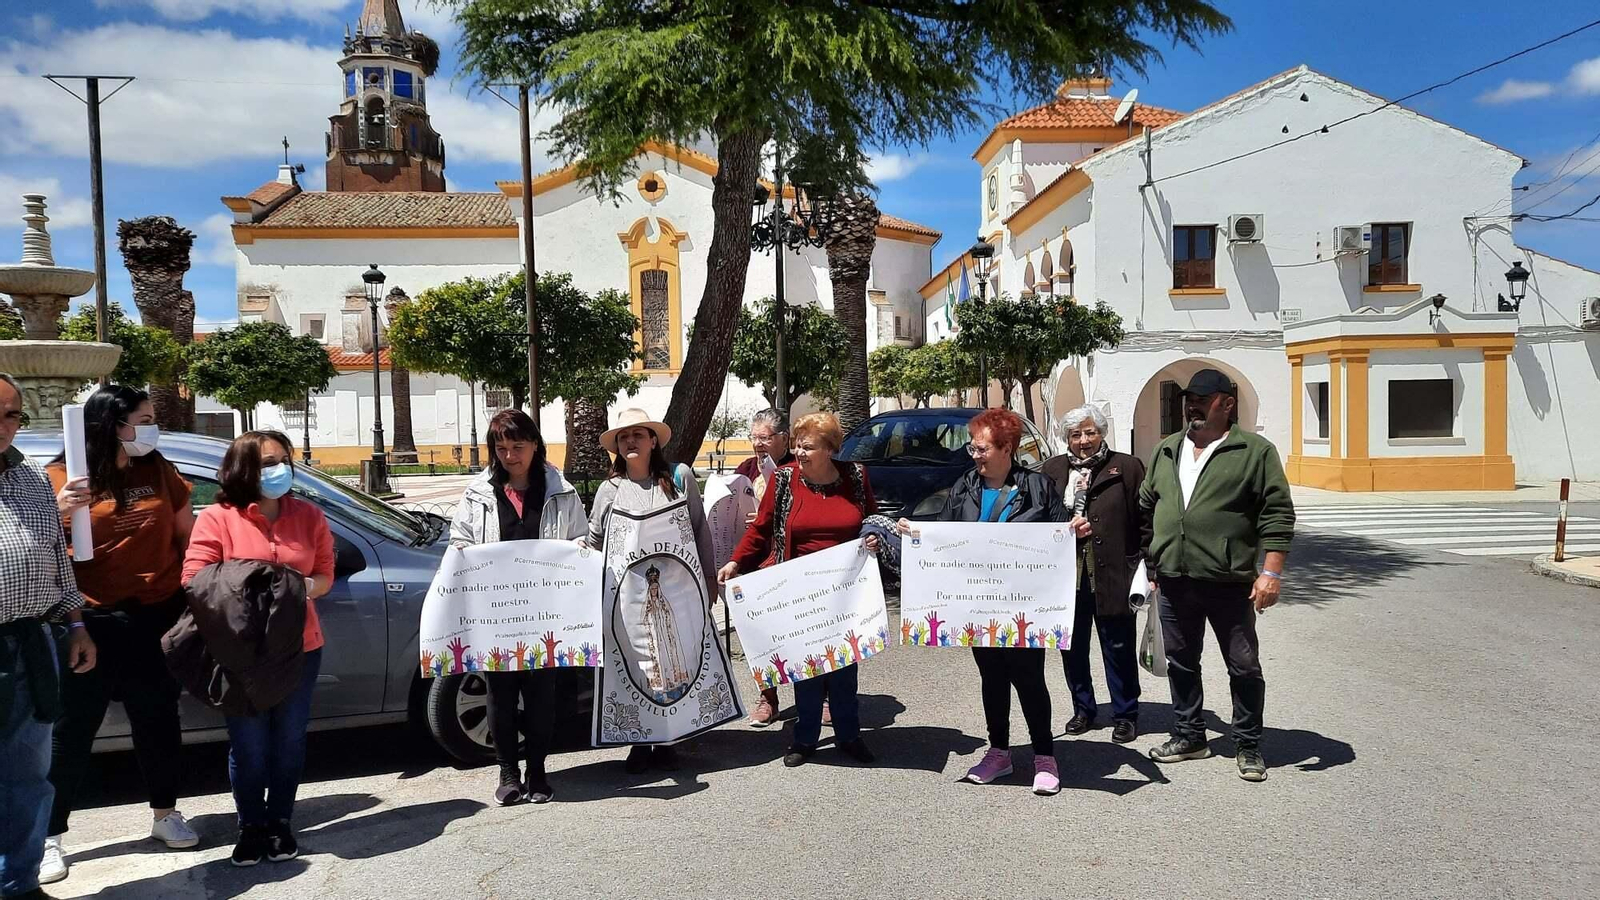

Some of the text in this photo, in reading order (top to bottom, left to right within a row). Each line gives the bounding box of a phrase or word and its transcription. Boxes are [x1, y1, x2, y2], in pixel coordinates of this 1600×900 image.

[654, 542, 671, 552] DE
[918, 558, 937, 570] Que
[940, 559, 966, 569] nadie
[987, 561, 1012, 571] quite
[1015, 560, 1024, 569] lo
[1027, 562, 1045, 572] que
[437, 578, 584, 597] Que nadie nos quite lo que es
[966, 577, 1004, 585] nuestro.
[747, 575, 867, 620] Que nadie nos quite lo que es
[936, 590, 953, 601] Por
[976, 592, 1007, 601] ermita
[1010, 593, 1036, 602] libre.
[490, 598, 531, 609] nuestro.
[459, 610, 564, 626] Por una ermita libre.
[794, 607, 828, 620] nuestro.
[771, 611, 859, 643] Por una ermita libre.
[612, 647, 678, 718] VALSEQUILLO
